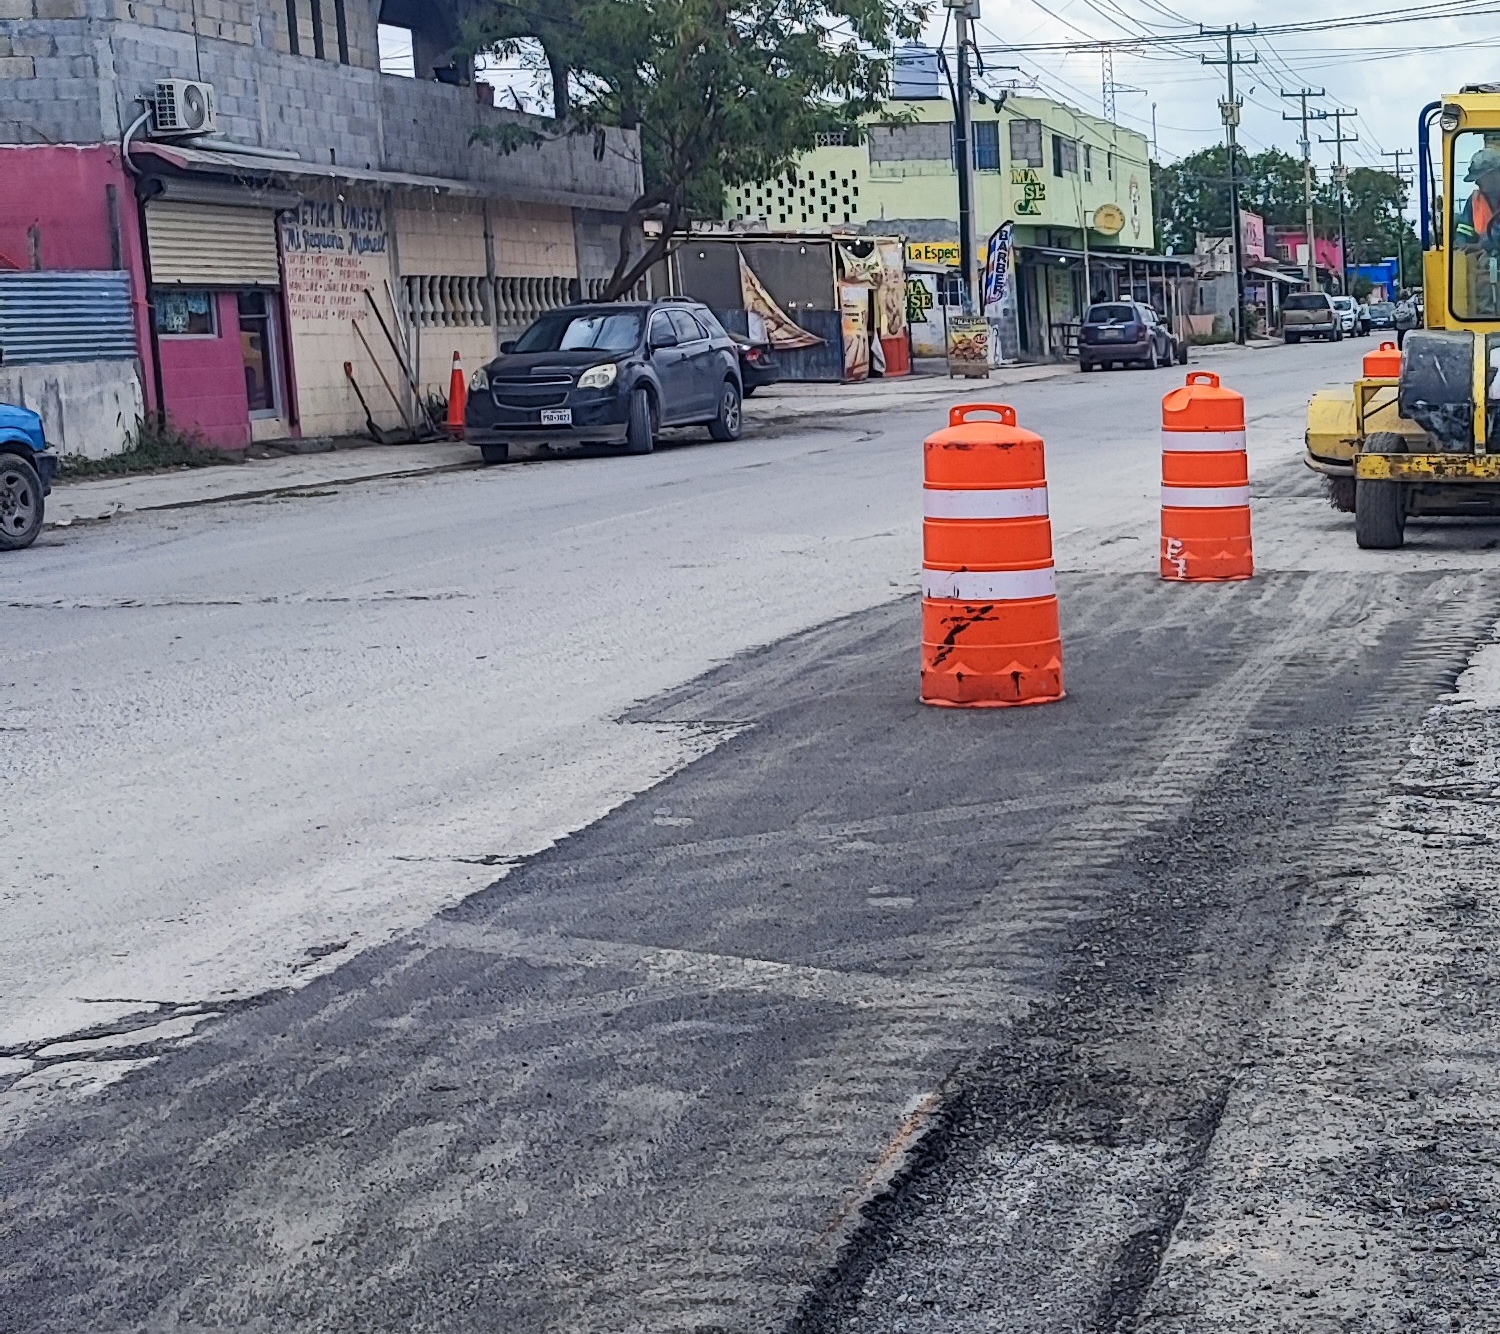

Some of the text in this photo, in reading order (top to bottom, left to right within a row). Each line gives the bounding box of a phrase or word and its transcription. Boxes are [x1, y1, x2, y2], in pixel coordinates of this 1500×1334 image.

[1010, 169, 1041, 184] MA
[341, 202, 383, 232] UNISEX
[908, 244, 960, 263] La Especi
